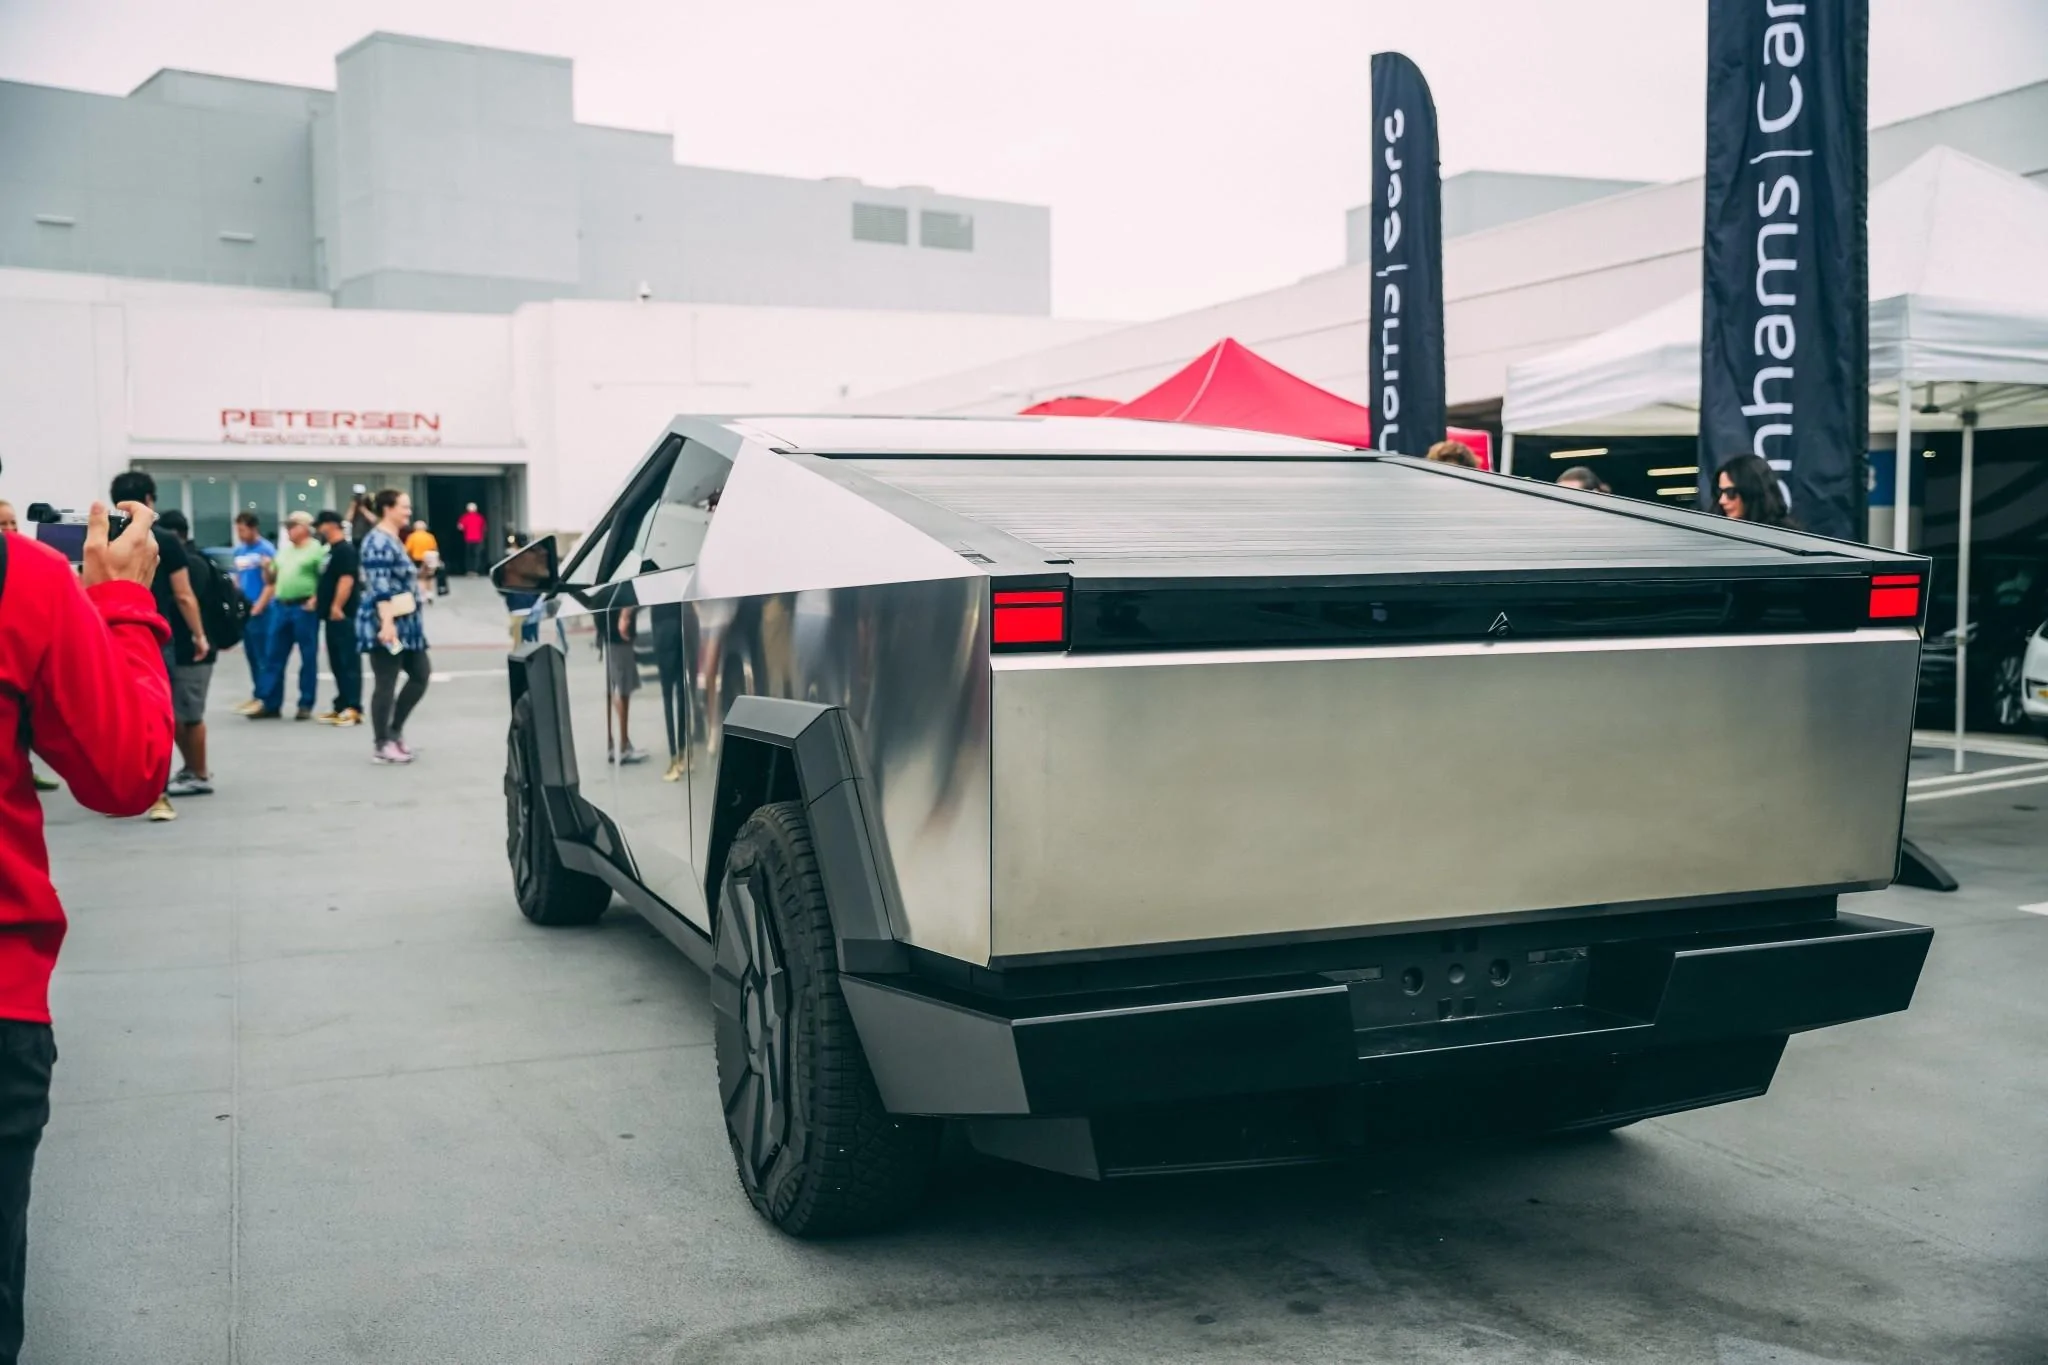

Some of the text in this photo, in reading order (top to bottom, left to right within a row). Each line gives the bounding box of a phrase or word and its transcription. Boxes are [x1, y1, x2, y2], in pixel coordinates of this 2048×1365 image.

[1740, 174, 1800, 511] nhams
[219, 408, 442, 430] PETERSEN
[221, 432, 442, 448] AUTOMOTIVE MUSEUM
